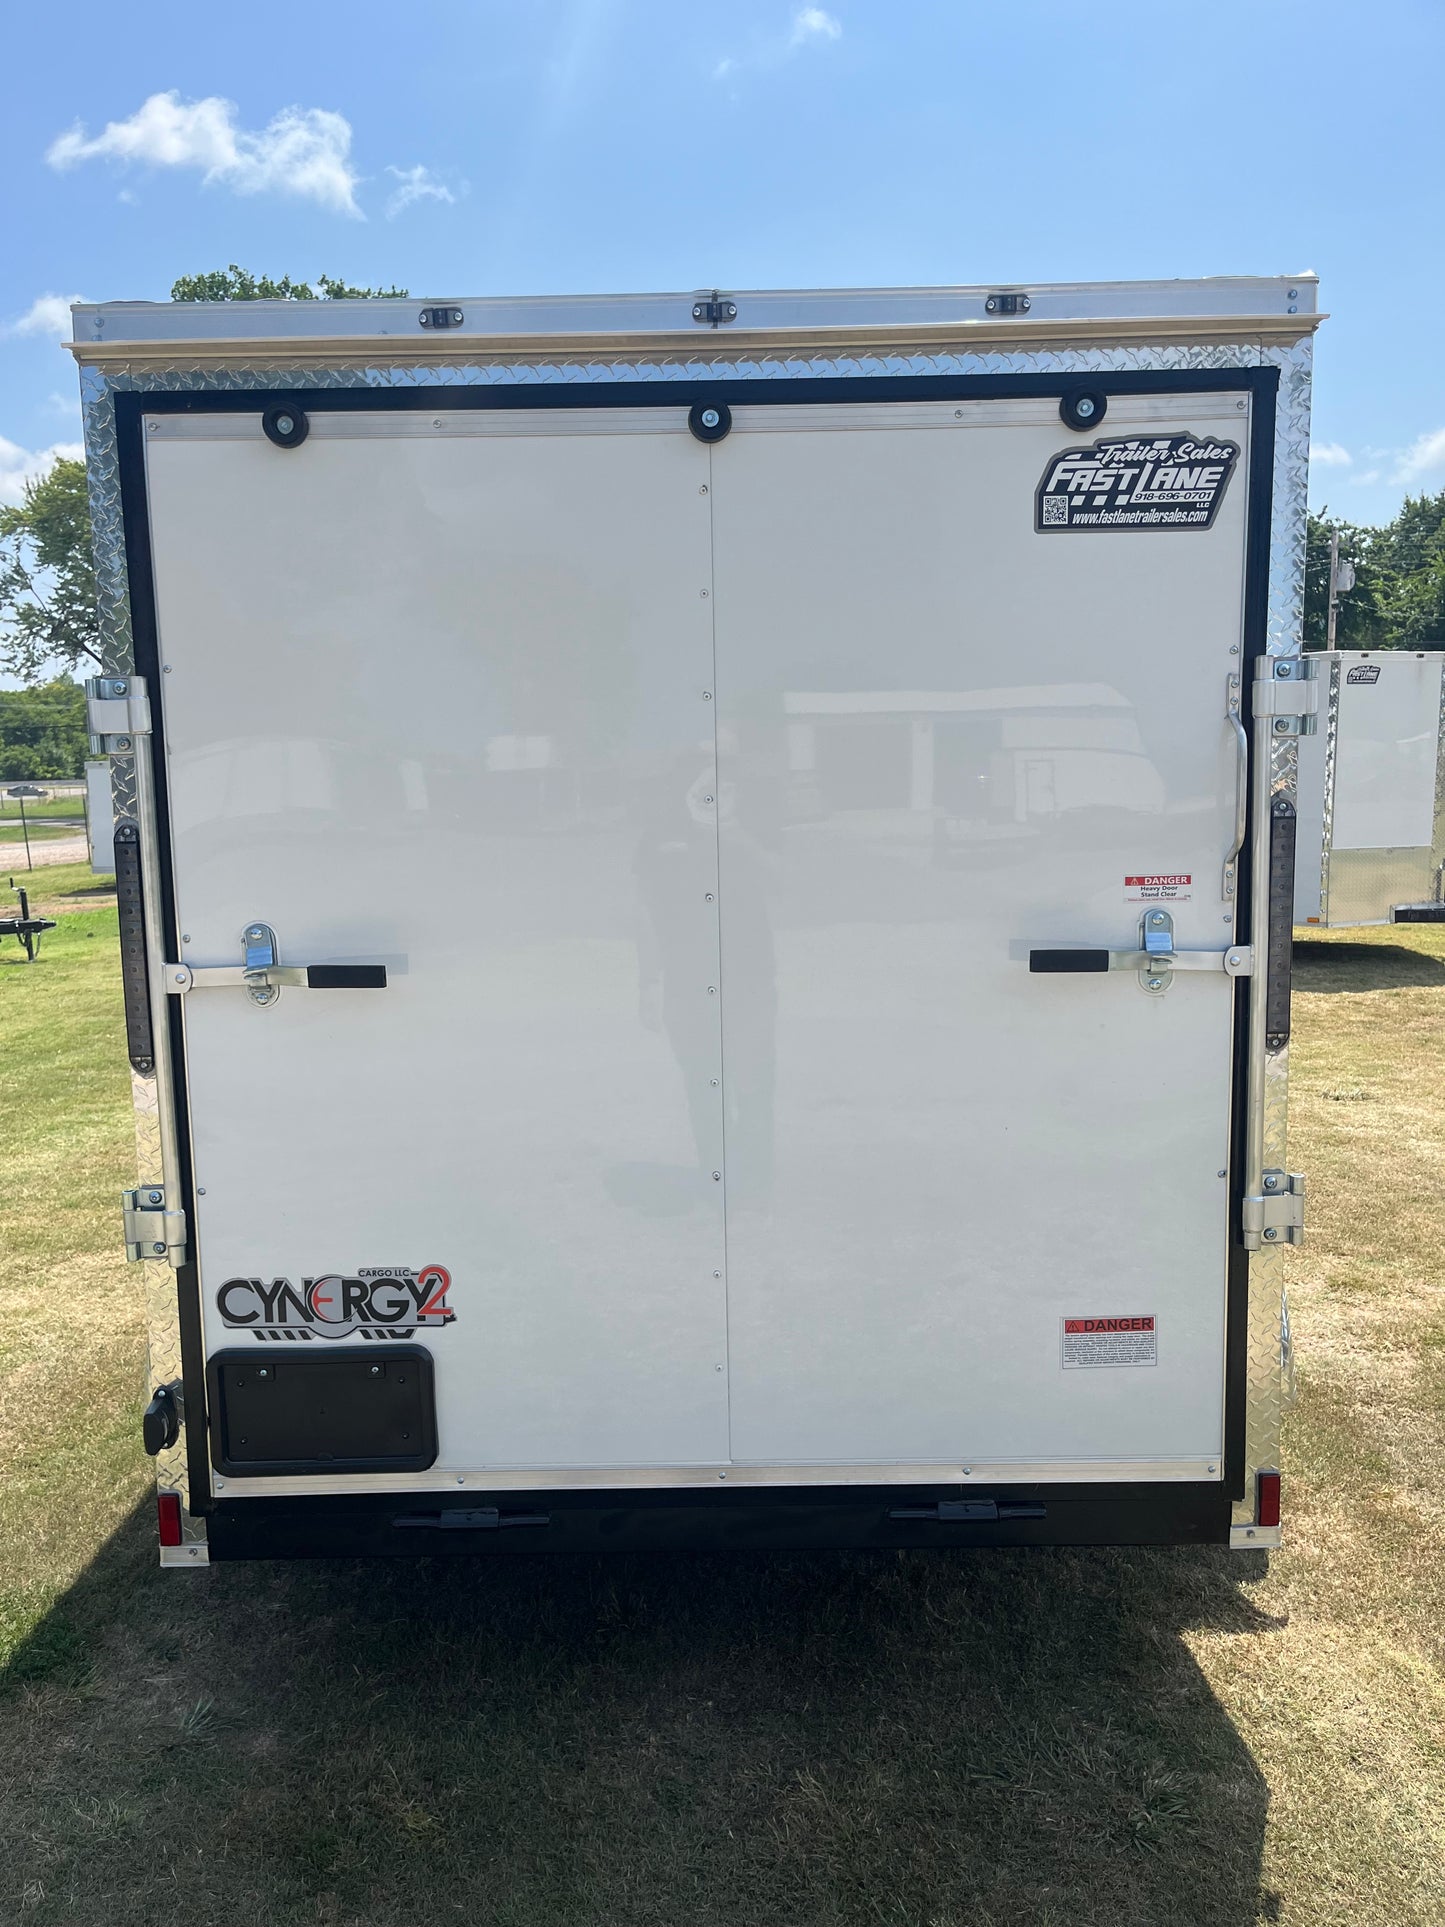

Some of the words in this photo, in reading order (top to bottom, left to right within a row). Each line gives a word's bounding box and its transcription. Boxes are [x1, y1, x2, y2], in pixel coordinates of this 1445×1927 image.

[1101, 445, 1171, 464] Trailer
[1173, 442, 1232, 463] Sales
[1134, 491, 1212, 501] 918-696-0701
[1072, 508, 1209, 524] www.fastlanetrailersales.com
[1144, 877, 1188, 885] DANGER
[358, 1269, 393, 1277] CARGO
[394, 1269, 410, 1277] LLC
[1084, 1318, 1152, 1331] DANGER
